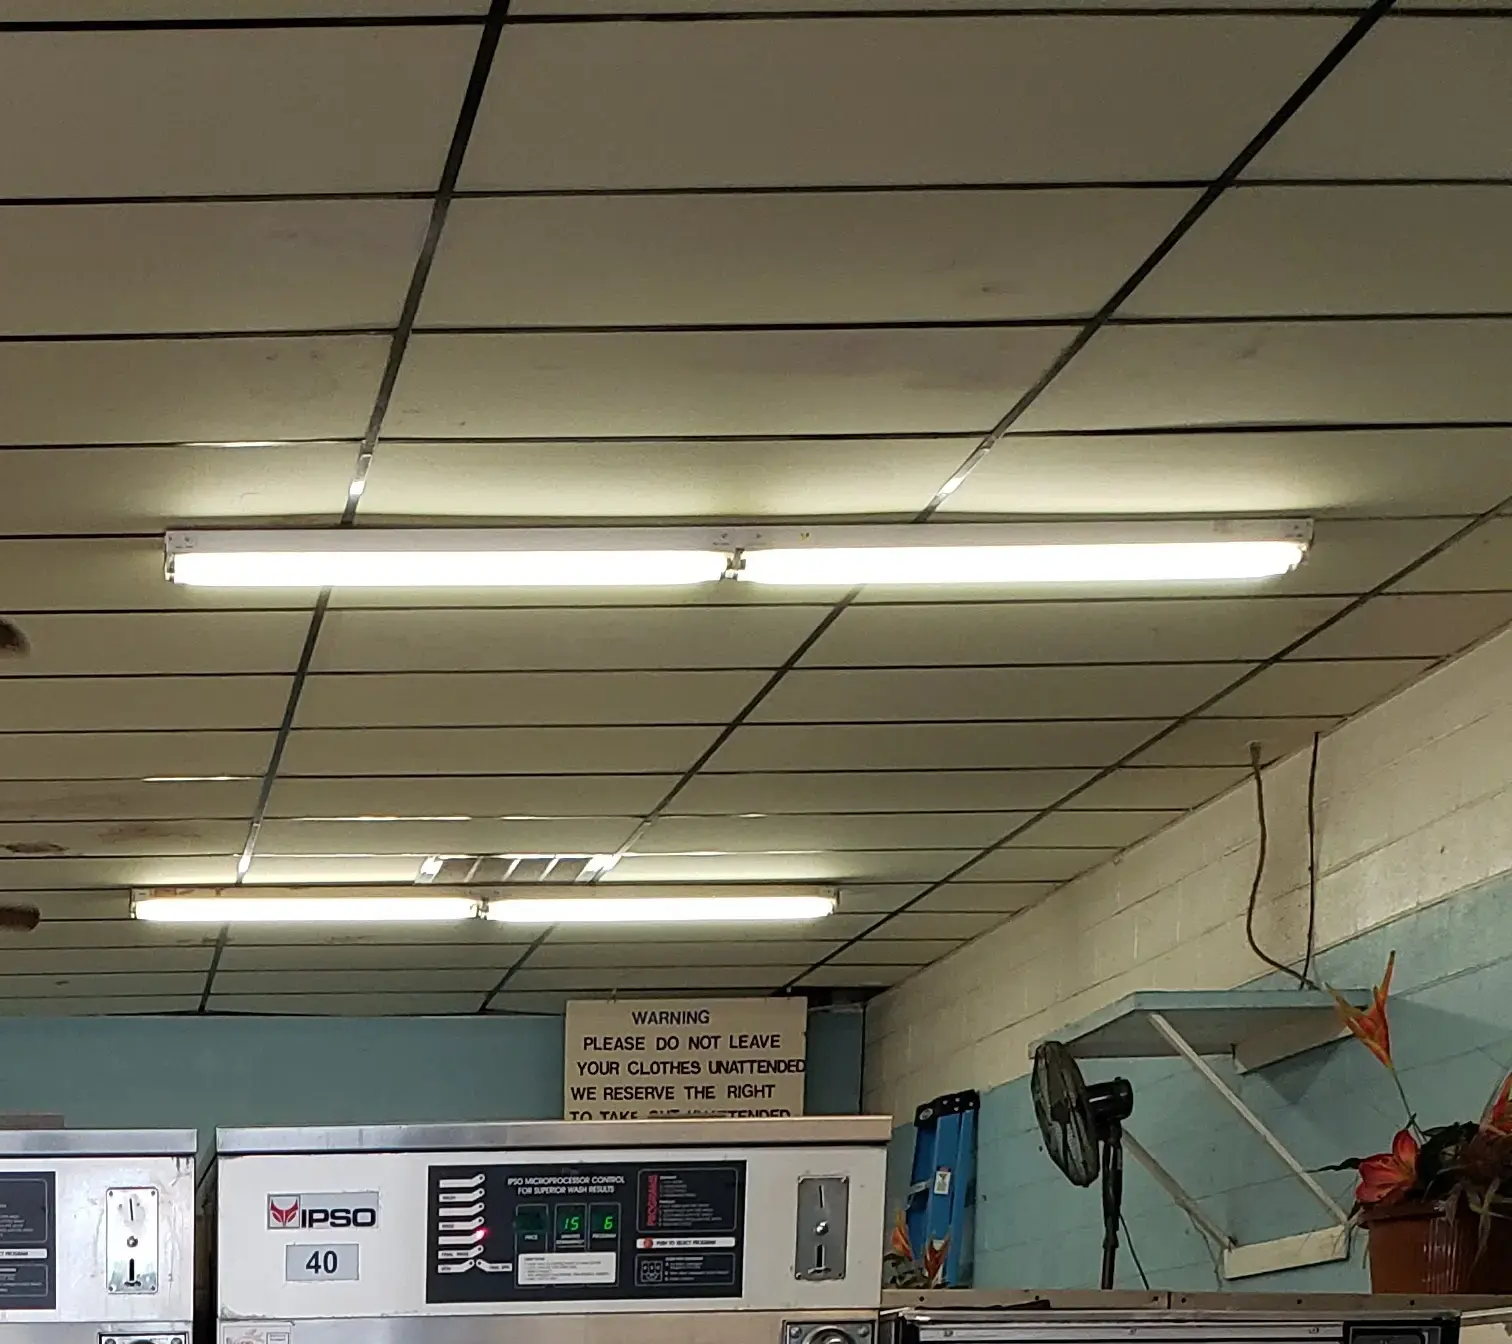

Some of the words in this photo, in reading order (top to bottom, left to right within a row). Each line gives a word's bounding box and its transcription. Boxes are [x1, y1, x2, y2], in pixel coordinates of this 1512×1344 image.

[632, 1010, 710, 1025] WARNING
[583, 1036, 645, 1051] PLEASE
[656, 1036, 679, 1050] DO
[688, 1035, 722, 1050] NOT
[729, 1034, 780, 1049] LEAVE
[577, 1061, 619, 1076] YOUR
[627, 1061, 701, 1075] CLOTHES
[708, 1059, 806, 1075] UNATTENDED
[571, 1086, 596, 1101] WE
[604, 1085, 674, 1100] RESERVE
[684, 1085, 715, 1099] THE
[727, 1084, 775, 1099] RIGHT
[592, 1176, 625, 1184] CONTROL
[518, 1187, 532, 1195] FOR
[301, 1208, 377, 1229] IPSO
[564, 1217, 579, 1231] 15
[604, 1216, 613, 1230] 6
[305, 1251, 338, 1276] 40
